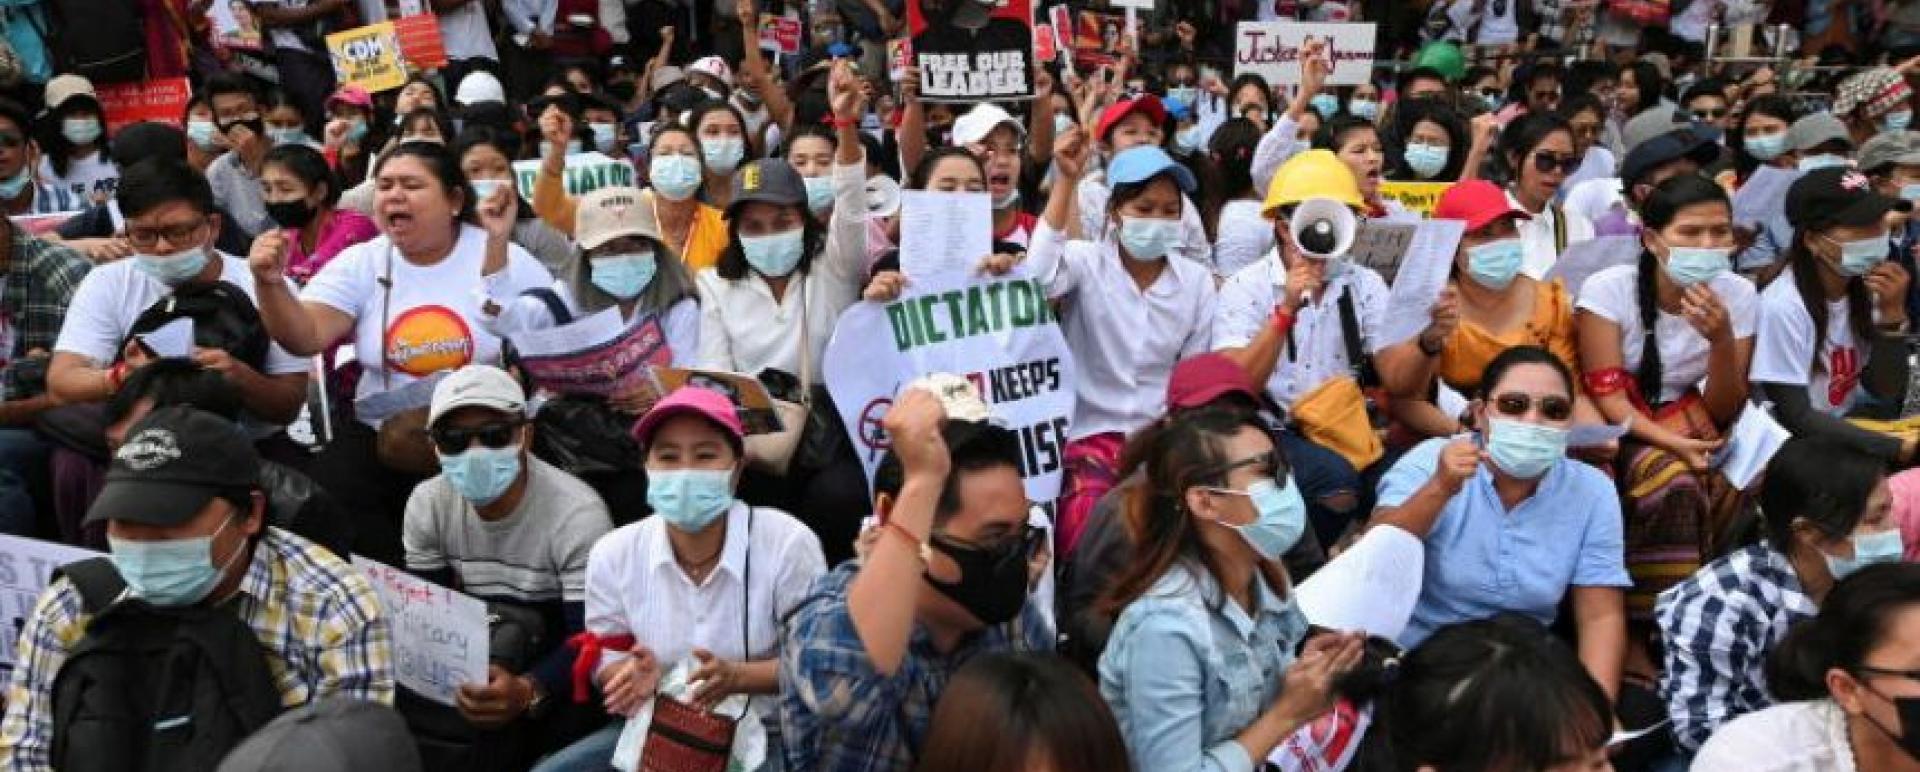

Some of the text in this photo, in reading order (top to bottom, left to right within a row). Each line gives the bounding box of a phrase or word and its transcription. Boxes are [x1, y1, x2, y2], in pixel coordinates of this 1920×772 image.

[919, 51, 1024, 72] FREE OUR
[922, 70, 1027, 95] LEADER
[989, 356, 1060, 404] KEEPS
